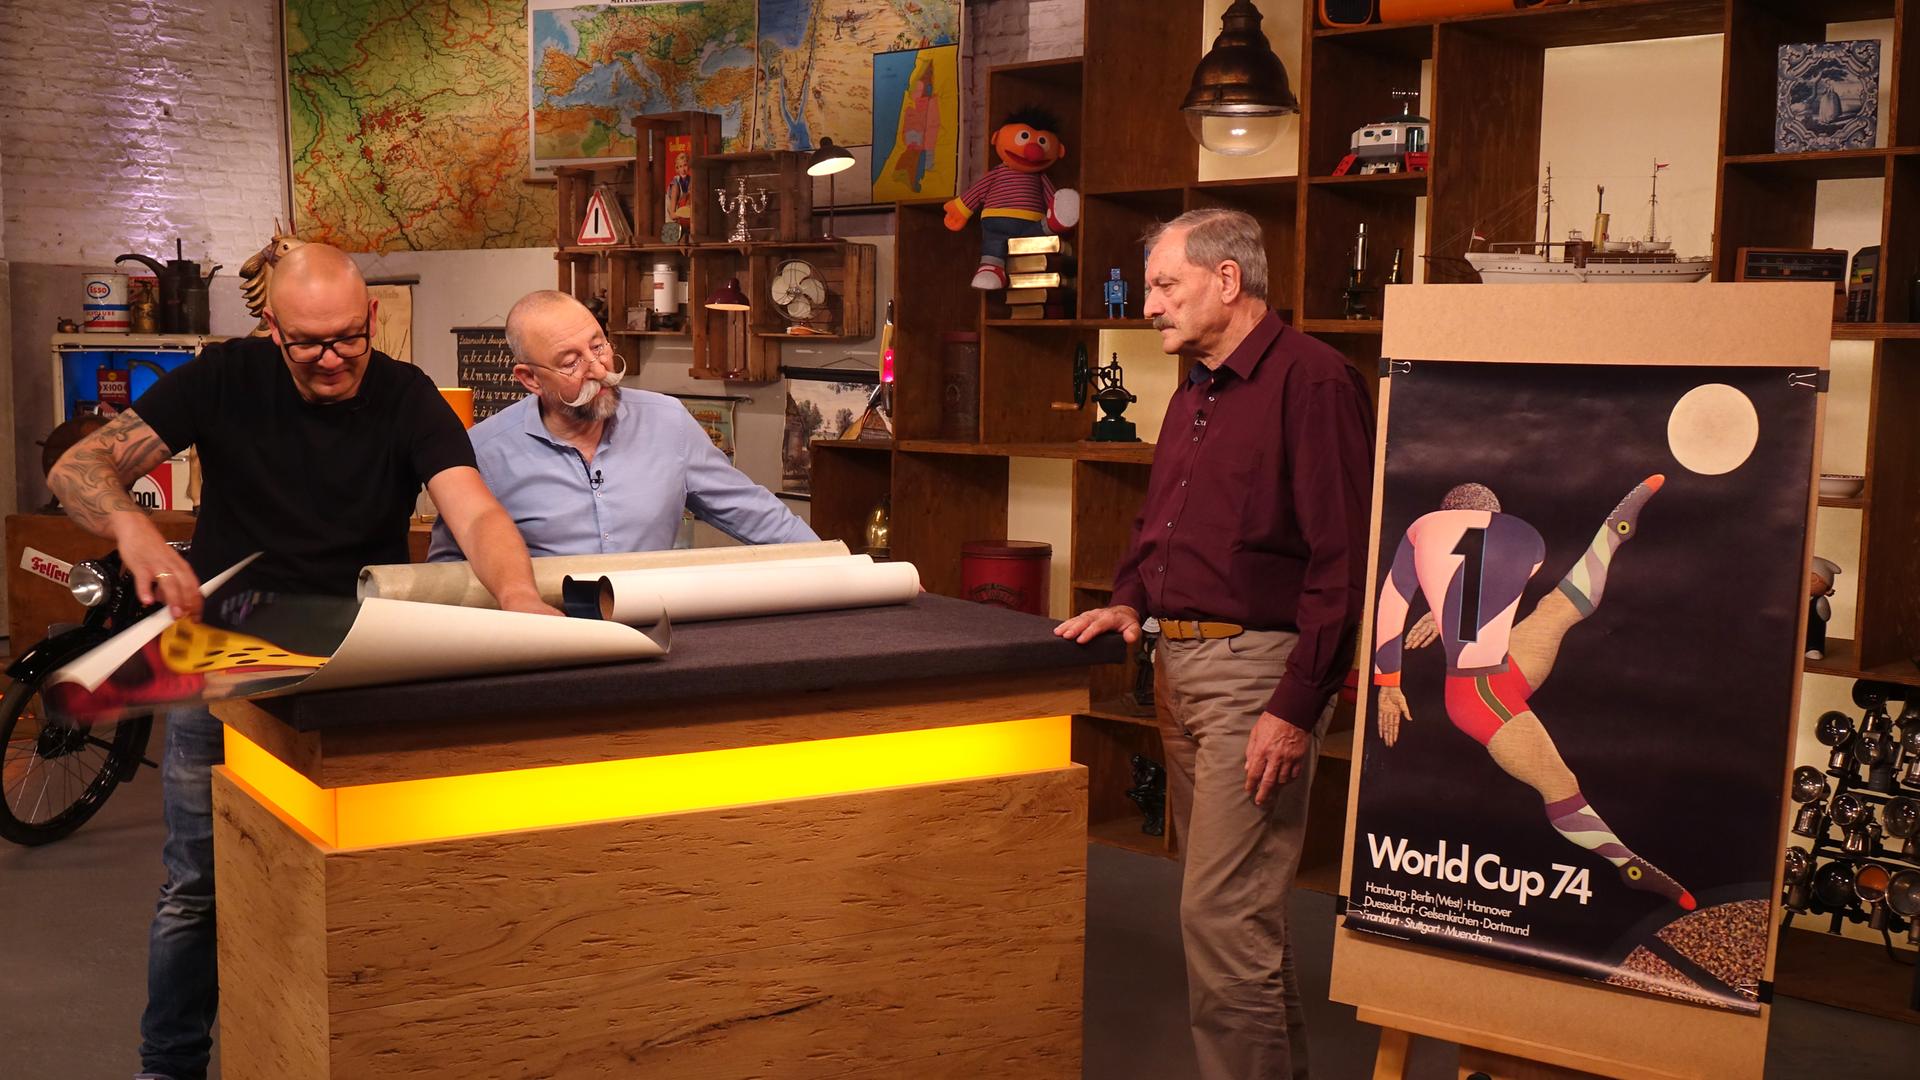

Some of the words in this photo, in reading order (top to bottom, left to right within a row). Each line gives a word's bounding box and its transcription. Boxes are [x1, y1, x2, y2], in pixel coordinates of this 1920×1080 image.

[103, 384, 123, 392] X-100
[1449, 527, 1487, 643] 1
[1367, 833, 1469, 884] World
[1474, 853, 1545, 906] Cup
[1549, 862, 1593, 905] 74
[1364, 895, 1415, 915] Duesseldorf
[1418, 906, 1479, 928] Gelsenkirchen
[1483, 917, 1530, 937] Dortmund
[1365, 881, 1407, 901] Hamburg
[1411, 889, 1435, 904] Berlin
[1435, 893, 1463, 911] (West)
[1467, 899, 1512, 918] Hannover
[1362, 909, 1400, 926] Frankfurt
[1404, 917, 1440, 934] Stuttgart
[1444, 925, 1493, 944] Muenchen
